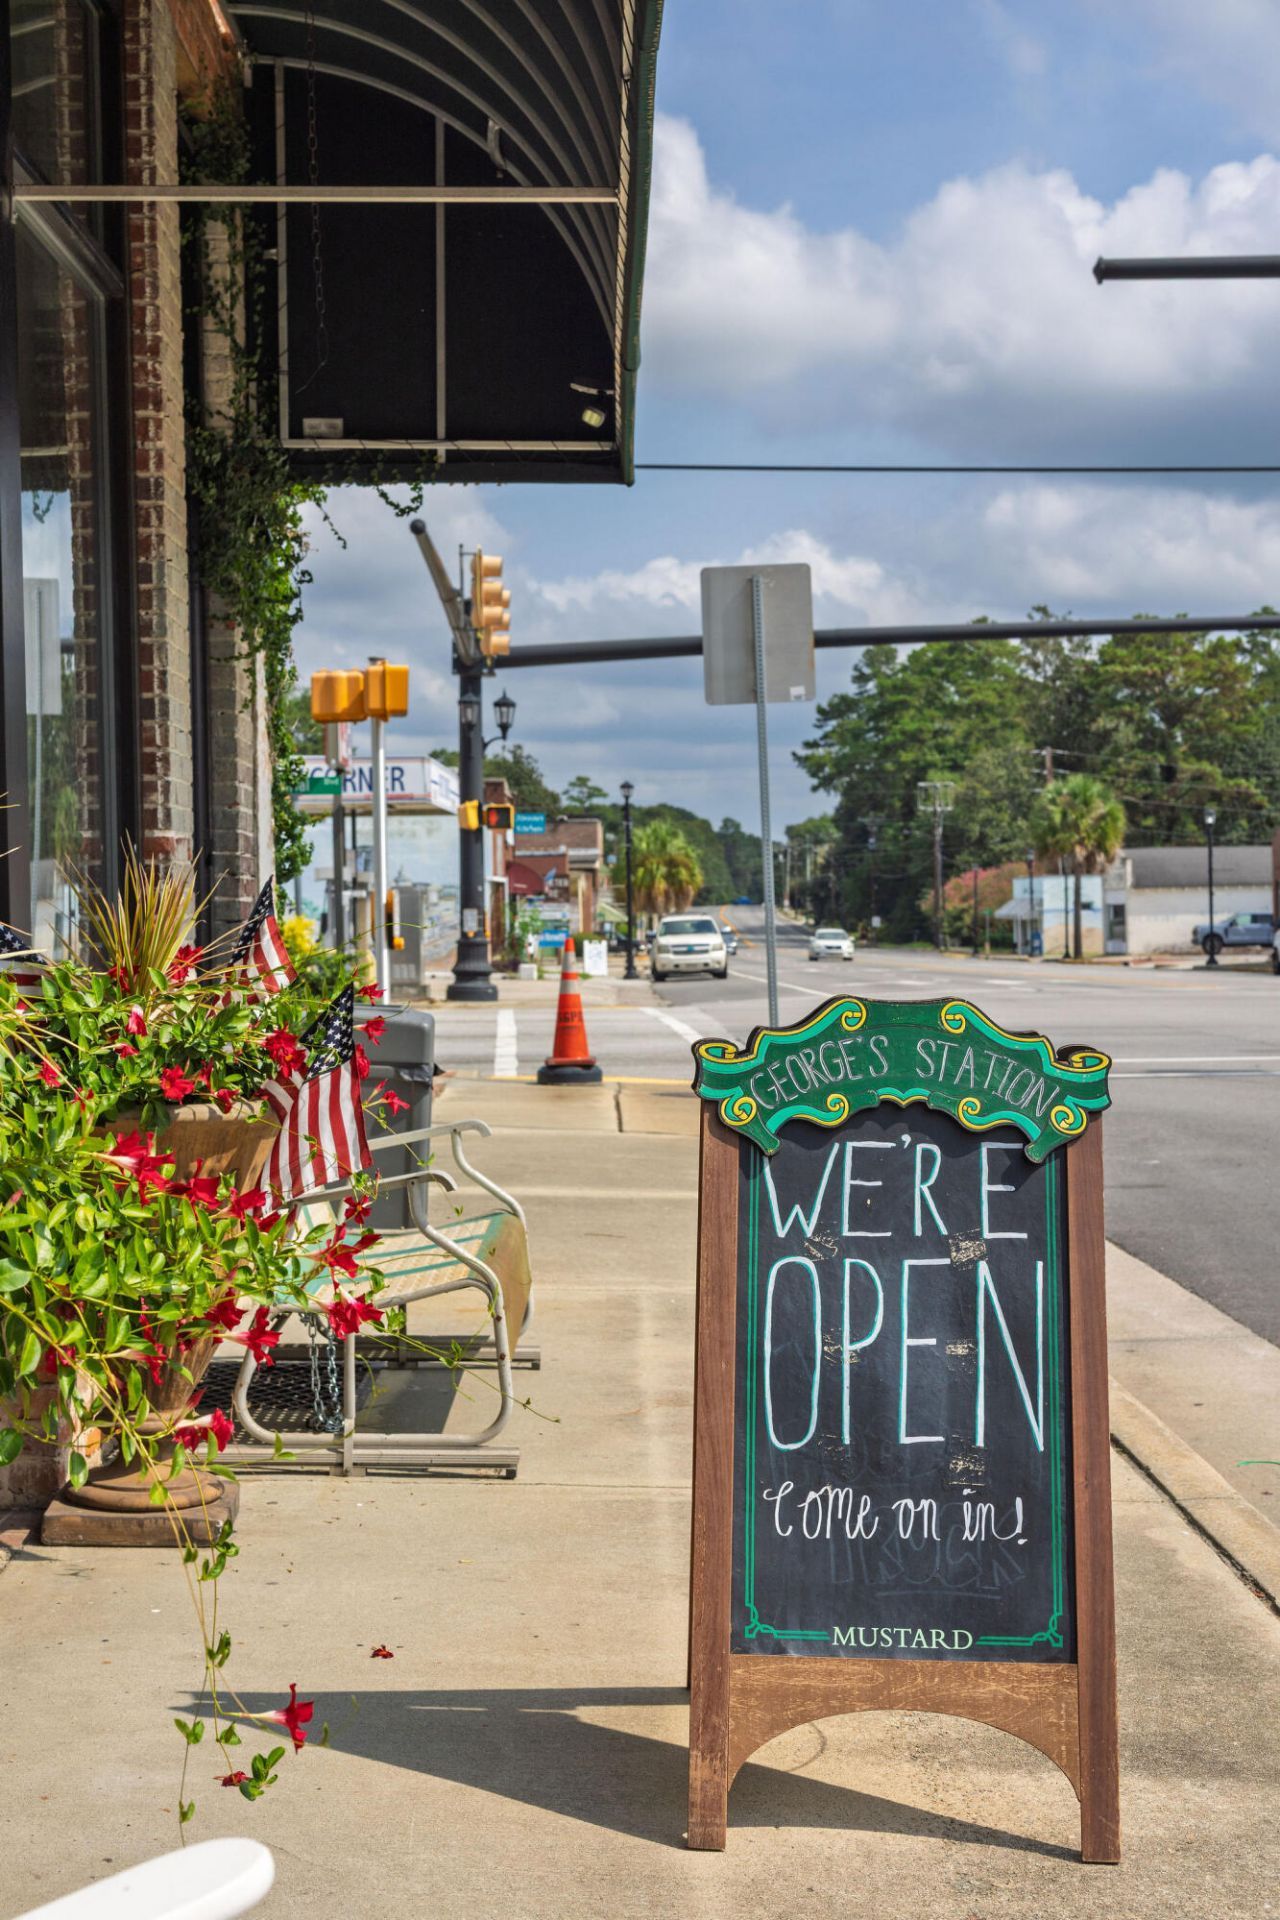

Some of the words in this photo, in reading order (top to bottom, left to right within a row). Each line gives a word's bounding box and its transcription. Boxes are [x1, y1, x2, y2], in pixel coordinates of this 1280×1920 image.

[310, 766, 406, 793] RNR
[750, 1035, 889, 1111] GEORGE'S
[915, 1038, 1060, 1118] STATION
[762, 1134, 1029, 1239] WE'RE
[763, 1256, 1045, 1453] OPEN
[763, 1481, 879, 1540] Come
[891, 1497, 941, 1542] on
[962, 1488, 1029, 1545] in!
[831, 1626, 973, 1650] MUSTARD
